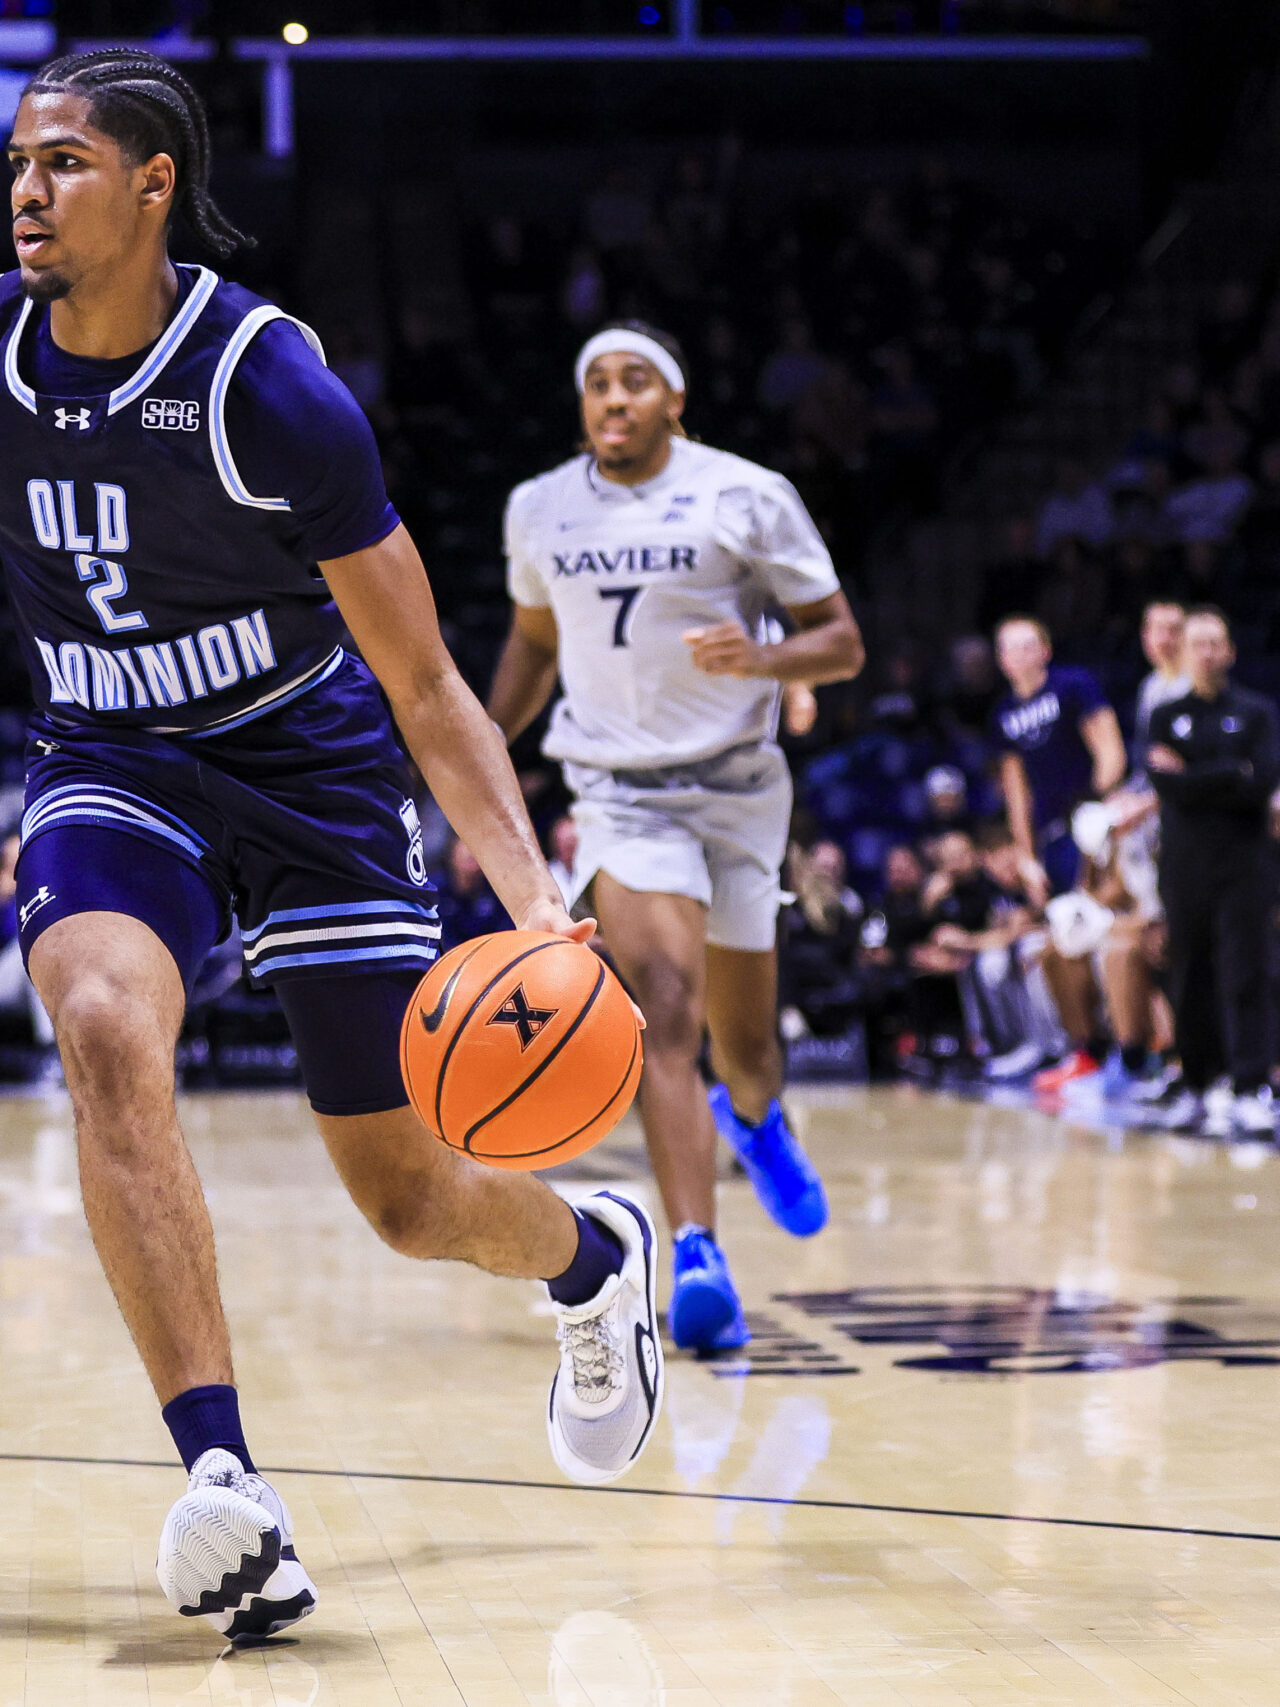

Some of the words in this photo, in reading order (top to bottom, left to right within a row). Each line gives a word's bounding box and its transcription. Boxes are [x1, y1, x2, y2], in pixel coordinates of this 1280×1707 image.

[141, 398, 200, 432] SBC
[26, 478, 130, 553] OLD
[74, 553, 149, 634] 2
[553, 544, 699, 577] XAVIER
[598, 583, 645, 649] 7
[34, 608, 278, 711] DOMINION
